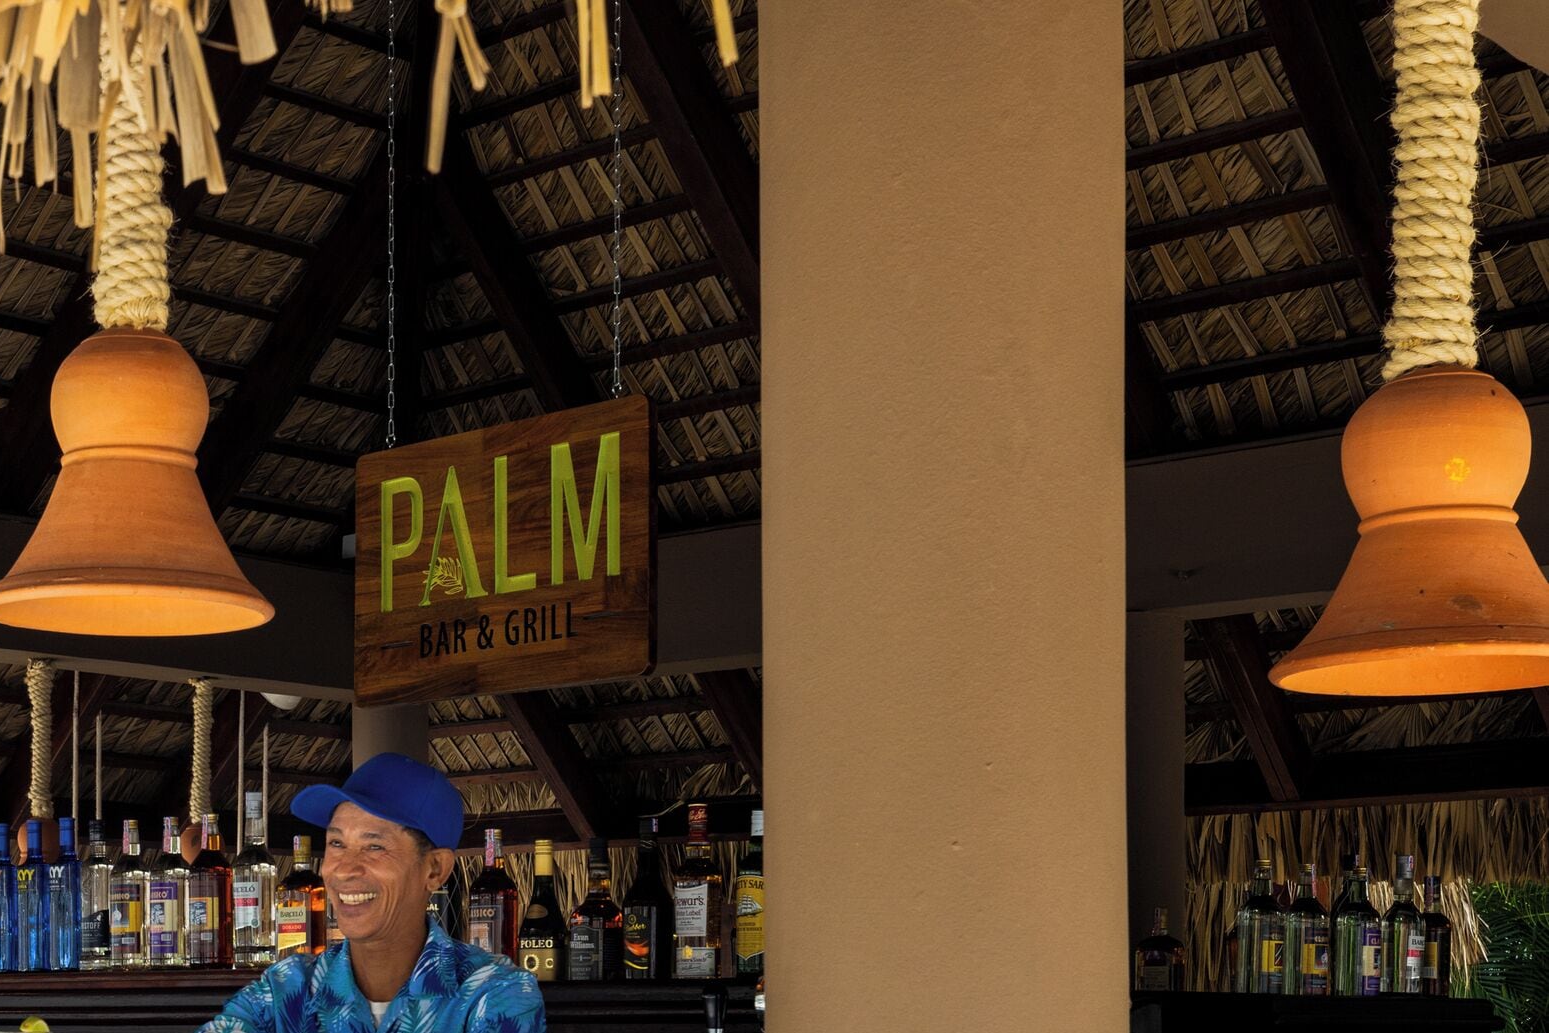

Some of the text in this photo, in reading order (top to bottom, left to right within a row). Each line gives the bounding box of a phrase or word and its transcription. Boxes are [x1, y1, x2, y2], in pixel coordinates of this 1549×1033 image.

[381, 431, 621, 614] PALM
[419, 602, 579, 659] BAR & GRILL
[573, 933, 589, 941] Evan
